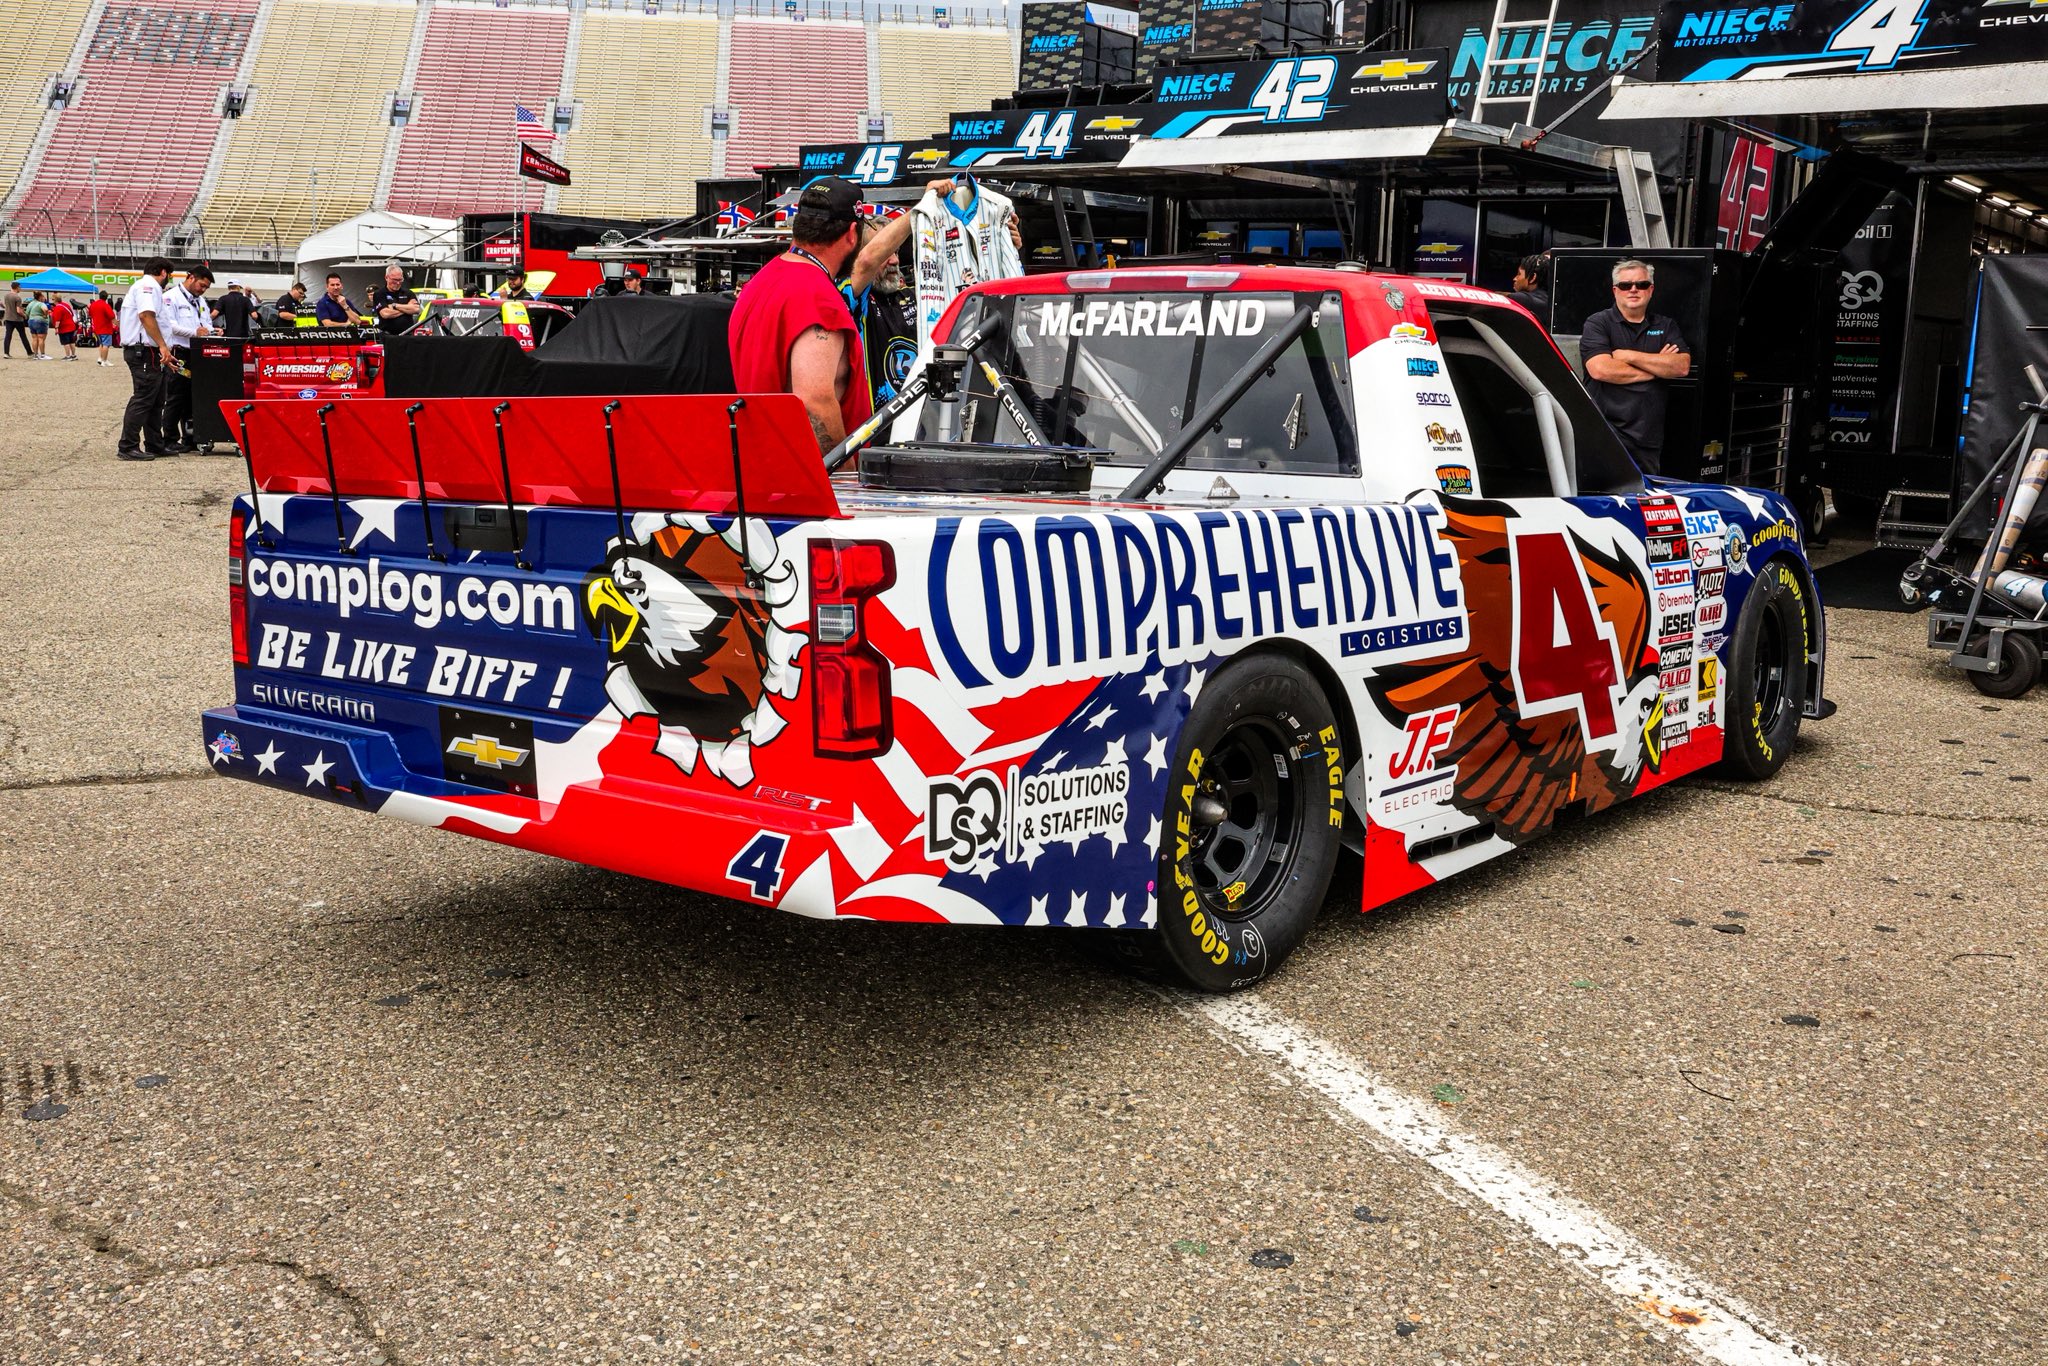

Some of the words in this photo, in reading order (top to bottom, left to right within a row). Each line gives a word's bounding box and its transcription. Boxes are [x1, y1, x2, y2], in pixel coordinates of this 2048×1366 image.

[1201, 2, 1243, 10] MOTORSPORTS
[1145, 23, 1193, 40] NIECE
[1678, 4, 1796, 38] NIECE
[1979, 14, 2048, 28] CHEV
[1031, 34, 1079, 49] NIECE
[1673, 33, 1758, 48] MOTORSPORTS
[1829, 0, 1920, 67] 4
[1450, 16, 1656, 78] NIECE
[1159, 72, 1236, 94] NIECE
[1251, 57, 1336, 121] 42
[1350, 82, 1438, 95] CHEVROLET
[1157, 92, 1213, 102] MOTORSPORTS
[951, 133, 990, 141] MOTORSPORTS
[952, 119, 1006, 135] NIECE
[1015, 112, 1074, 157] 44
[1083, 133, 1132, 141] CHEVROL
[525, 156, 566, 176] CRATSMAN
[804, 152, 846, 166] NIECE
[852, 145, 902, 184] 45
[810, 184, 831, 193] JGR
[1717, 136, 1774, 251] 42
[1854, 225, 1874, 239] bil
[92, 274, 139, 285] POET
[449, 308, 480, 318] BUTCHER
[1039, 301, 1266, 338] McFARLAND
[1838, 312, 1880, 320] LUTIONS
[260, 332, 298, 340] FOR
[299, 331, 352, 339] RACING
[276, 364, 326, 373] RIVERSIDE
[1408, 358, 1438, 372] NIECE
[1832, 374, 1878, 383] utoVentive
[1416, 392, 1451, 405] sparco
[1437, 466, 1471, 480] VICTORY
[1644, 509, 1679, 522] CRAFTSMAN
[1684, 514, 1720, 535] SKF
[1752, 518, 1798, 548] GOODYEAR
[1647, 539, 1673, 561] Holley
[1655, 568, 1691, 585] tilton
[1700, 570, 1724, 592] KLOTZ
[2004, 577, 2032, 597] 4
[247, 557, 576, 631] complog.com
[928, 502, 1459, 690] COMPREHENSIVE
[1667, 592, 1693, 606] brembo
[1659, 611, 1694, 636] JESEL
[1347, 619, 1458, 652] LOGISTICS
[1513, 530, 1621, 744] 4
[1661, 645, 1692, 666] COMETIC
[547, 667, 573, 710] !
[1659, 668, 1691, 690] CALICO
[252, 682, 376, 724] SILVERADO
[1662, 722, 1687, 740] LINCOLN
[1318, 724, 1344, 829] EAGLE
[753, 785, 832, 811] RST
[1023, 769, 1127, 808] SOLUTIONS
[1384, 783, 1452, 814] ELECTRIC
[1023, 818, 1035, 840] &
[1038, 801, 1125, 838] STAFFING
[728, 832, 789, 900] 4
[1174, 748, 1229, 966] GOODYEAR
